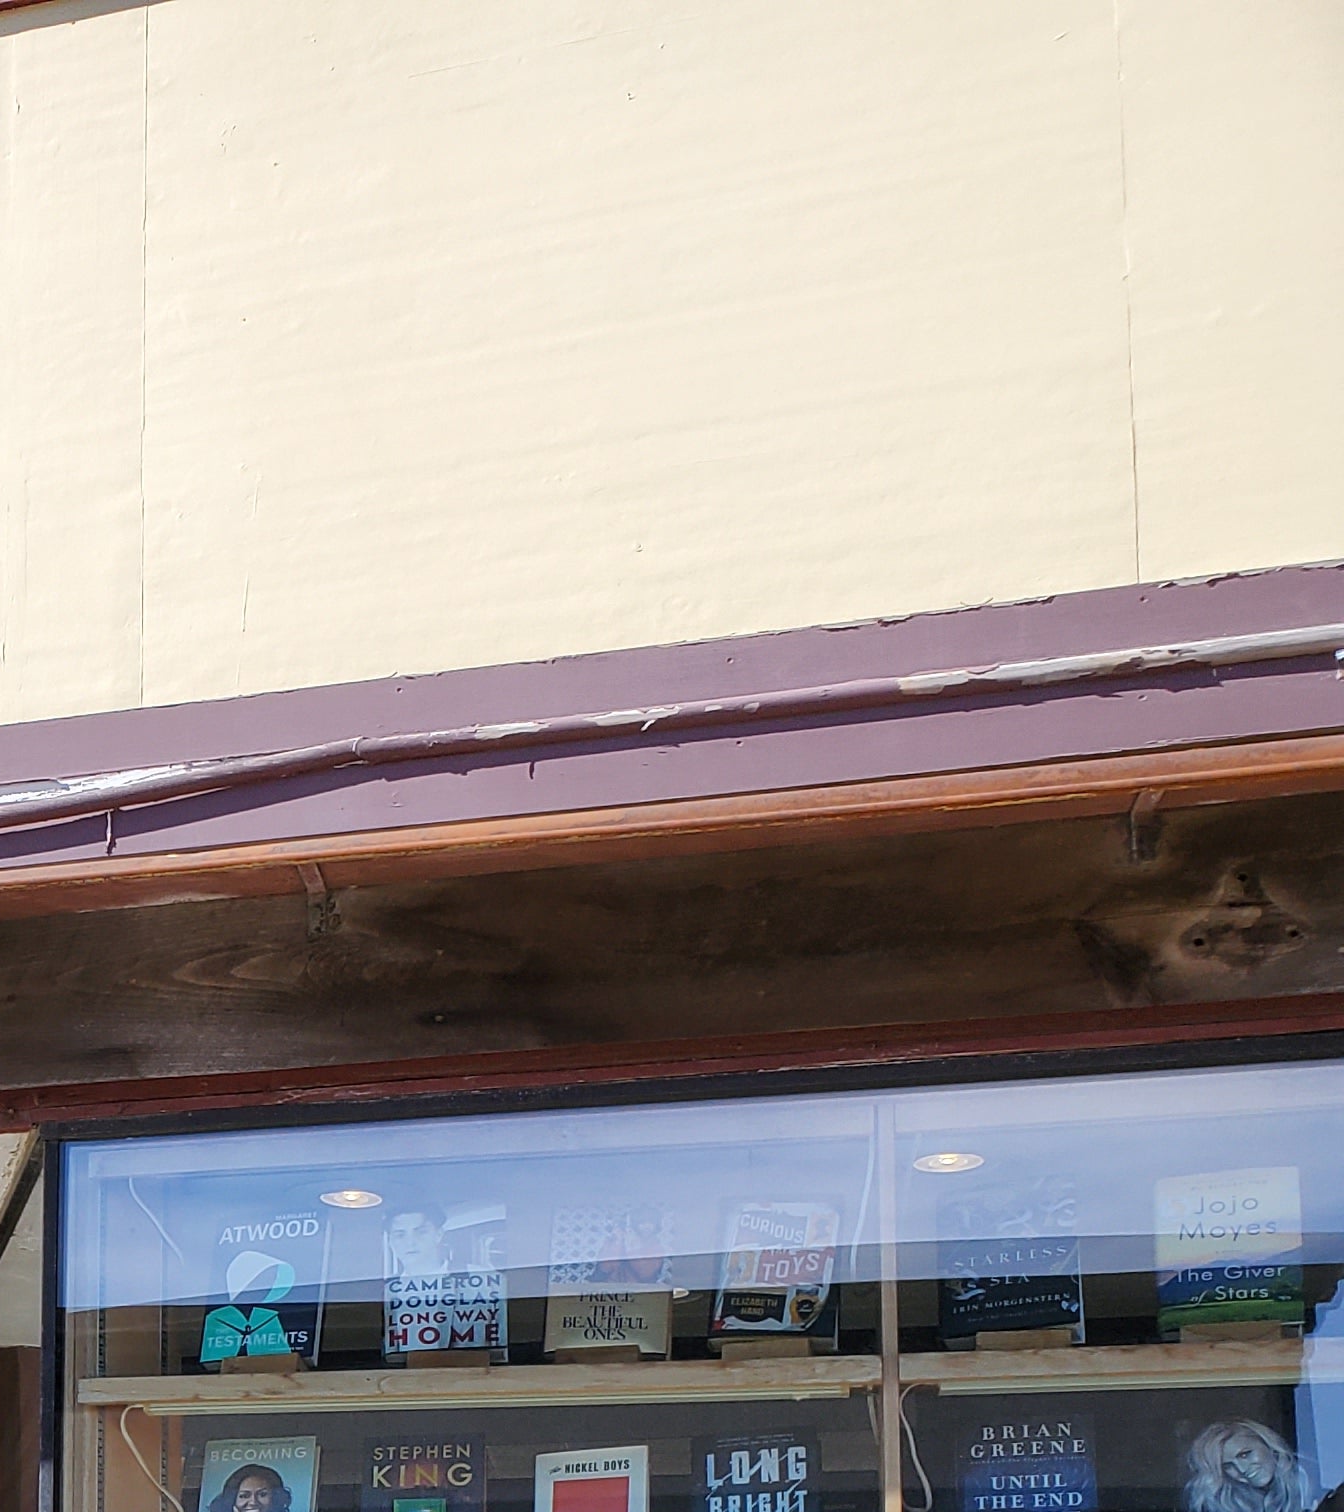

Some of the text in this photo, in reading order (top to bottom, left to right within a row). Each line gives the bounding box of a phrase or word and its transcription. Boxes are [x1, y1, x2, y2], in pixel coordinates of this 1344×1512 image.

[1194, 1194, 1259, 1215] Jojo
[219, 1219, 319, 1246] ATWOOD
[740, 1212, 805, 1242] CURIOUS
[1179, 1220, 1277, 1242] Moyes
[954, 1245, 1067, 1268] STARLESS
[762, 1251, 820, 1281] TOYS
[1177, 1265, 1285, 1284] The Giver
[389, 1274, 501, 1293] CAMERON
[989, 1272, 1030, 1287] SEA
[389, 1291, 500, 1309] DOUGLAS
[1215, 1286, 1269, 1300] Stars
[389, 1308, 500, 1326] LONG WAY
[591, 1305, 622, 1318] THE
[562, 1316, 648, 1332] BEAUTIFUL
[207, 1331, 308, 1348] TESTAMENTS
[389, 1324, 500, 1346] HOME
[584, 1328, 626, 1341] ONES
[982, 1422, 1072, 1441] BRIAN
[210, 1446, 307, 1463] BECOMING
[373, 1444, 471, 1461] STEPHEN
[970, 1439, 1086, 1458] GREENE
[372, 1462, 473, 1488] KING
[564, 1458, 631, 1474] NICKEL BOYS
[706, 1446, 807, 1487] LONG
[990, 1473, 1067, 1491] UNTIL
[974, 1492, 1083, 1510] THE END
